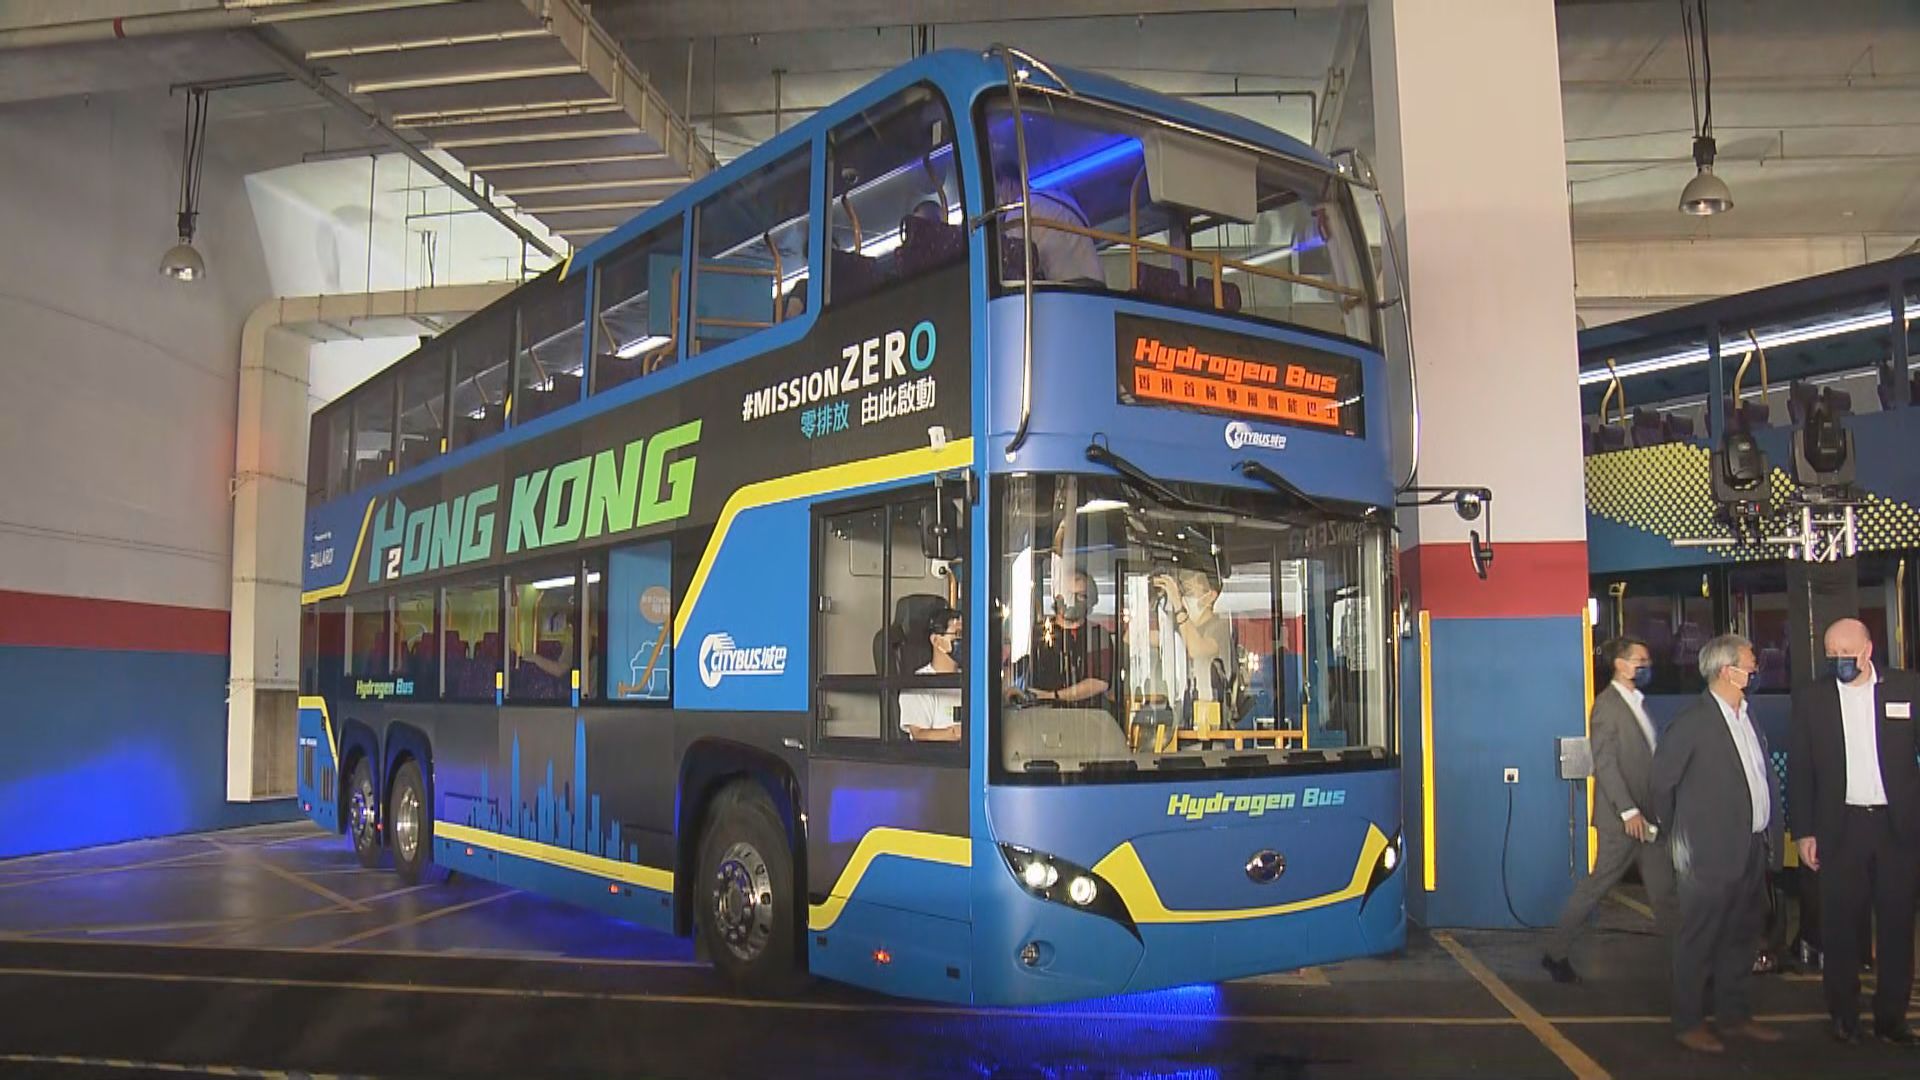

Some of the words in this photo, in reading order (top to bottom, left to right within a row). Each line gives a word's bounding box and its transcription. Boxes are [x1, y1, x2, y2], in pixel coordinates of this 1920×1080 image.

[1134, 337, 1278, 383] Hydrogen
[1285, 364, 1337, 393] Bus
[801, 400, 850, 439] 零排放
[861, 376, 935, 425] 由此啟動
[506, 418, 702, 554] KONG
[356, 680, 395, 699] Hydrogen
[396, 678, 414, 695] Bus
[1167, 792, 1296, 820] Hydrogen
[1302, 788, 1346, 808] Bus
